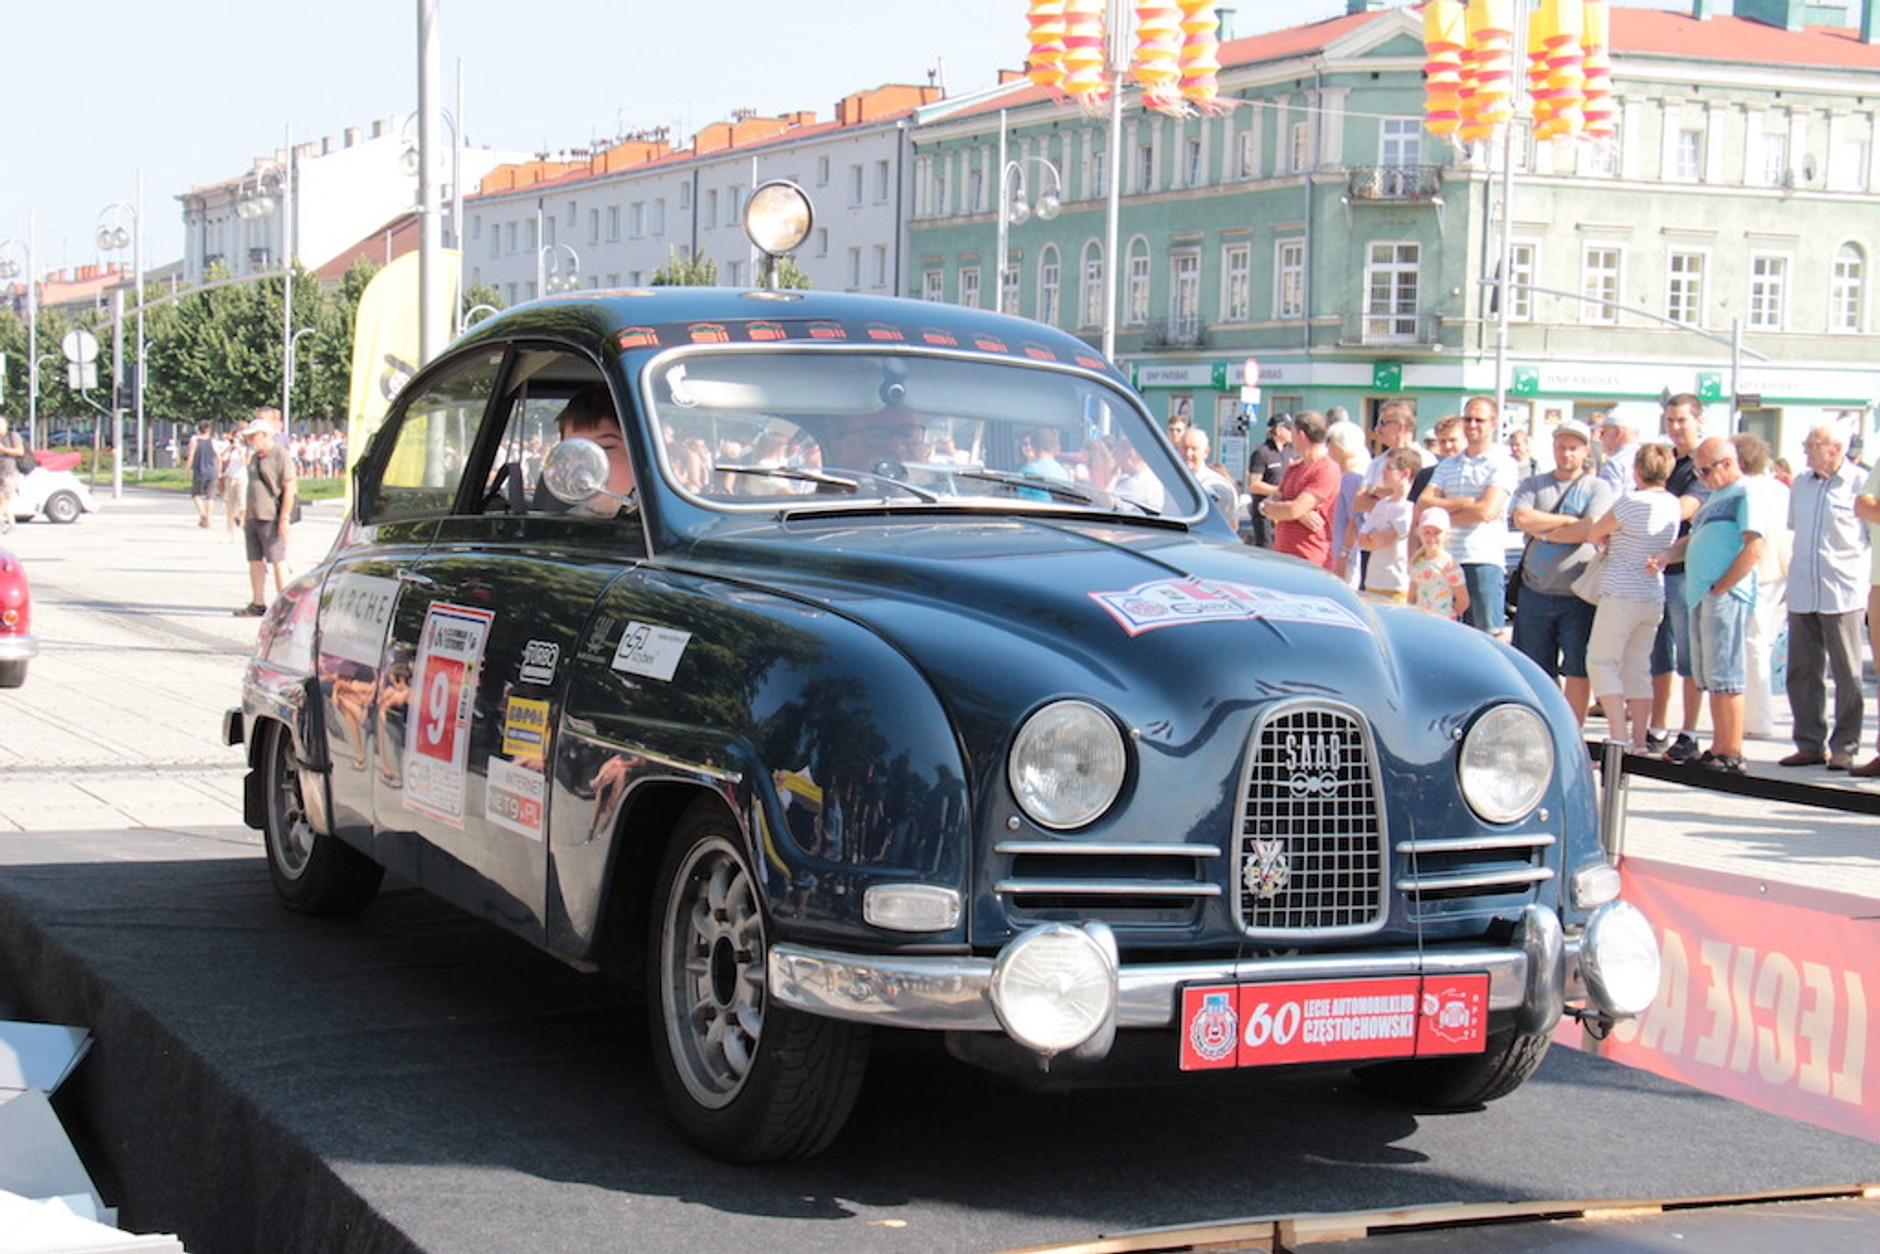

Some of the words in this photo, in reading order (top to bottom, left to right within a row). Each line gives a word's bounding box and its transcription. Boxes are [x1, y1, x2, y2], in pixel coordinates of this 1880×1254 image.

[426, 671, 450, 745] 9
[1286, 734, 1341, 771] SAAB
[1244, 1001, 1301, 1047] 60
[1304, 998, 1331, 1017] LECIE
[1332, 994, 1415, 1015] AUTOMOBILKLUB
[1303, 1014, 1414, 1046] CZĘSTOCHOWSKI
